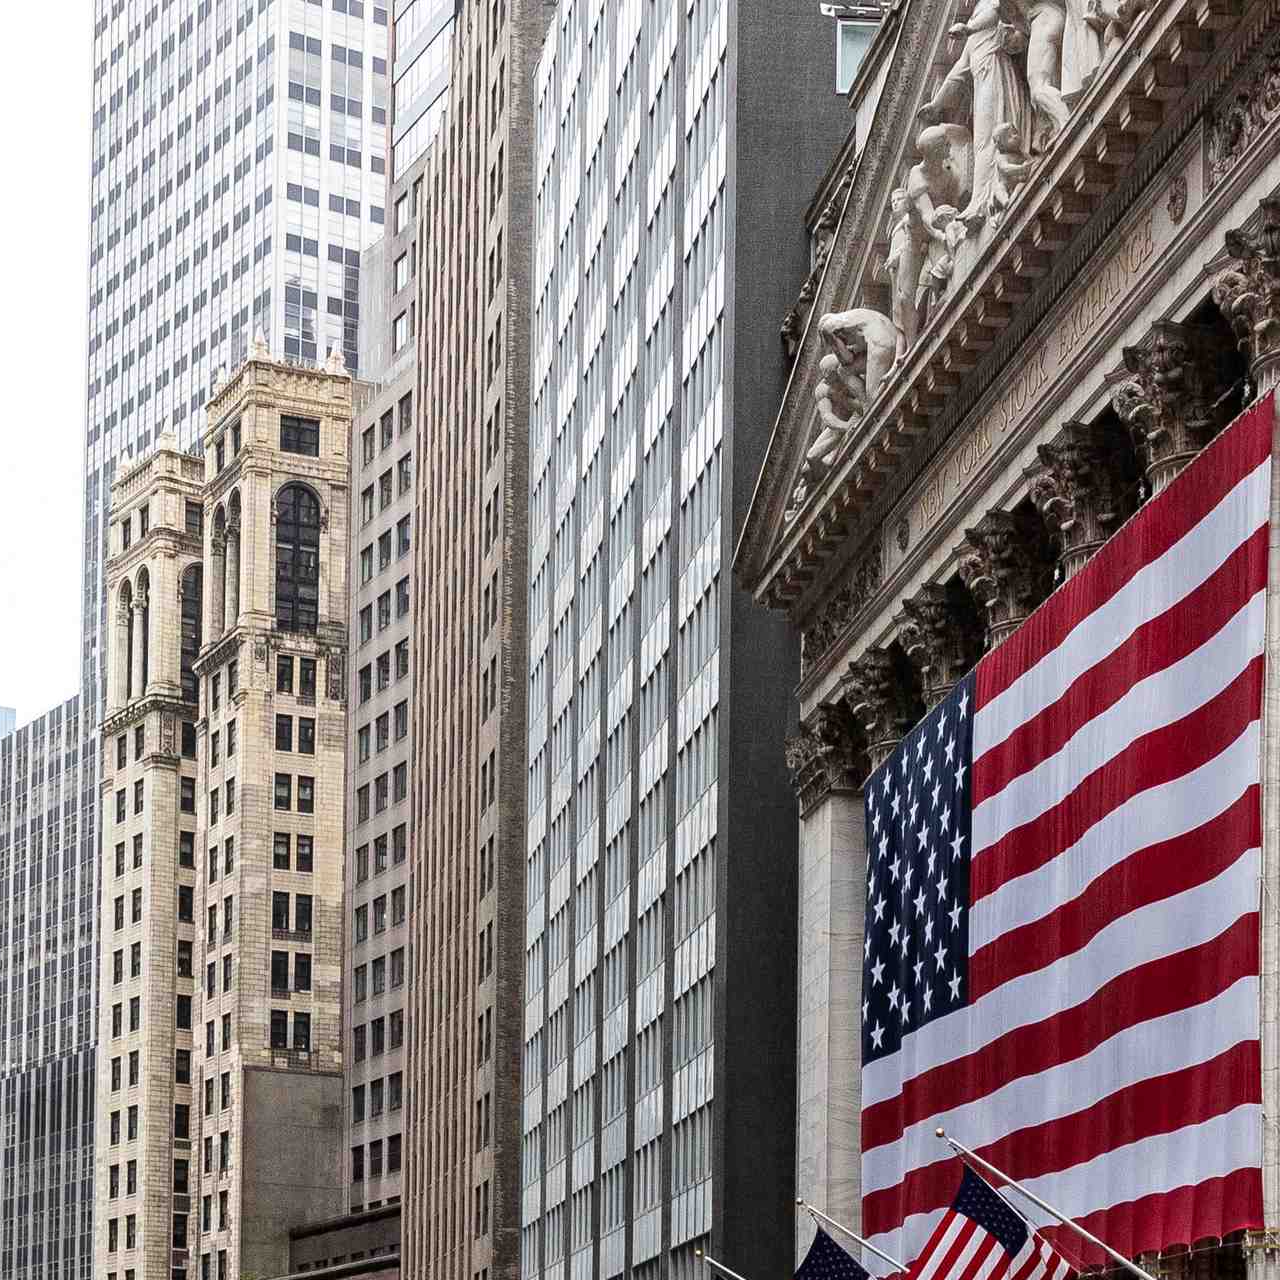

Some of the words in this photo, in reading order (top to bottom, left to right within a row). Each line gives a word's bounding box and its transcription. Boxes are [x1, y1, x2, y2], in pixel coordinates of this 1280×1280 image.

[953, 418, 993, 487] YORK
[999, 343, 1049, 432] STOCK
[1056, 216, 1154, 365] EXCHANGE
